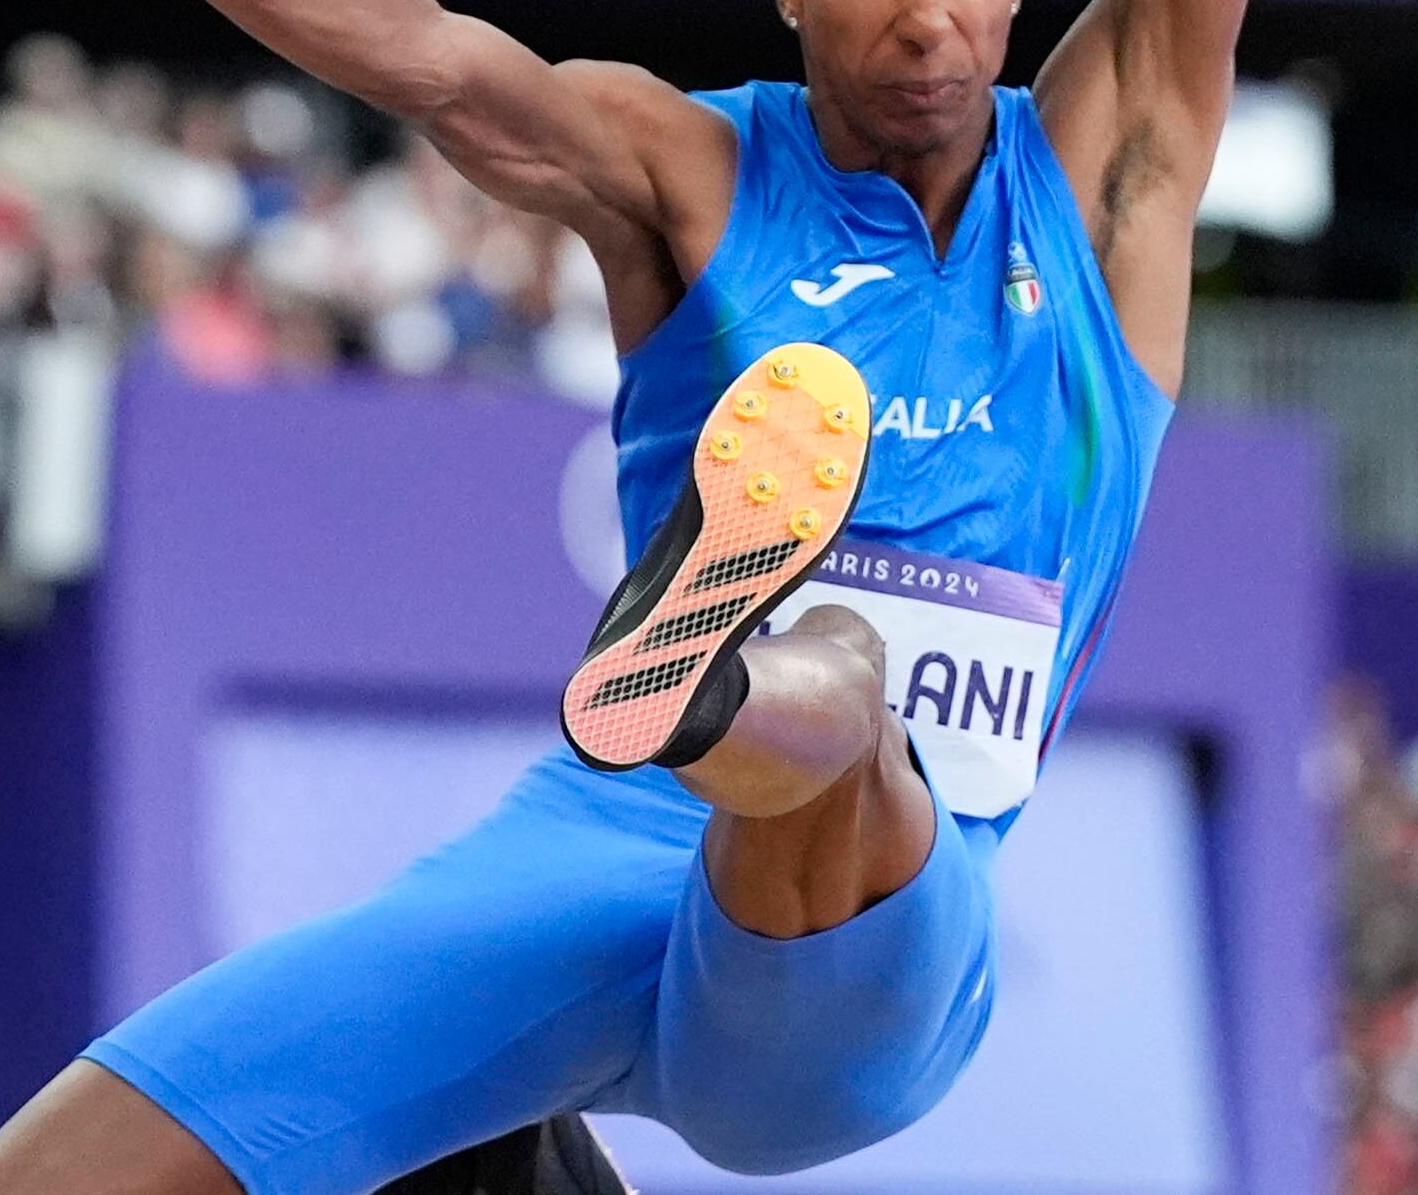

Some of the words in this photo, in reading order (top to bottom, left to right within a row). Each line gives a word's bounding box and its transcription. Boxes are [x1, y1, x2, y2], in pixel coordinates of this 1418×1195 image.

[871, 395, 994, 441] ALIA
[819, 551, 891, 581] ARIS
[900, 563, 980, 598] 2024
